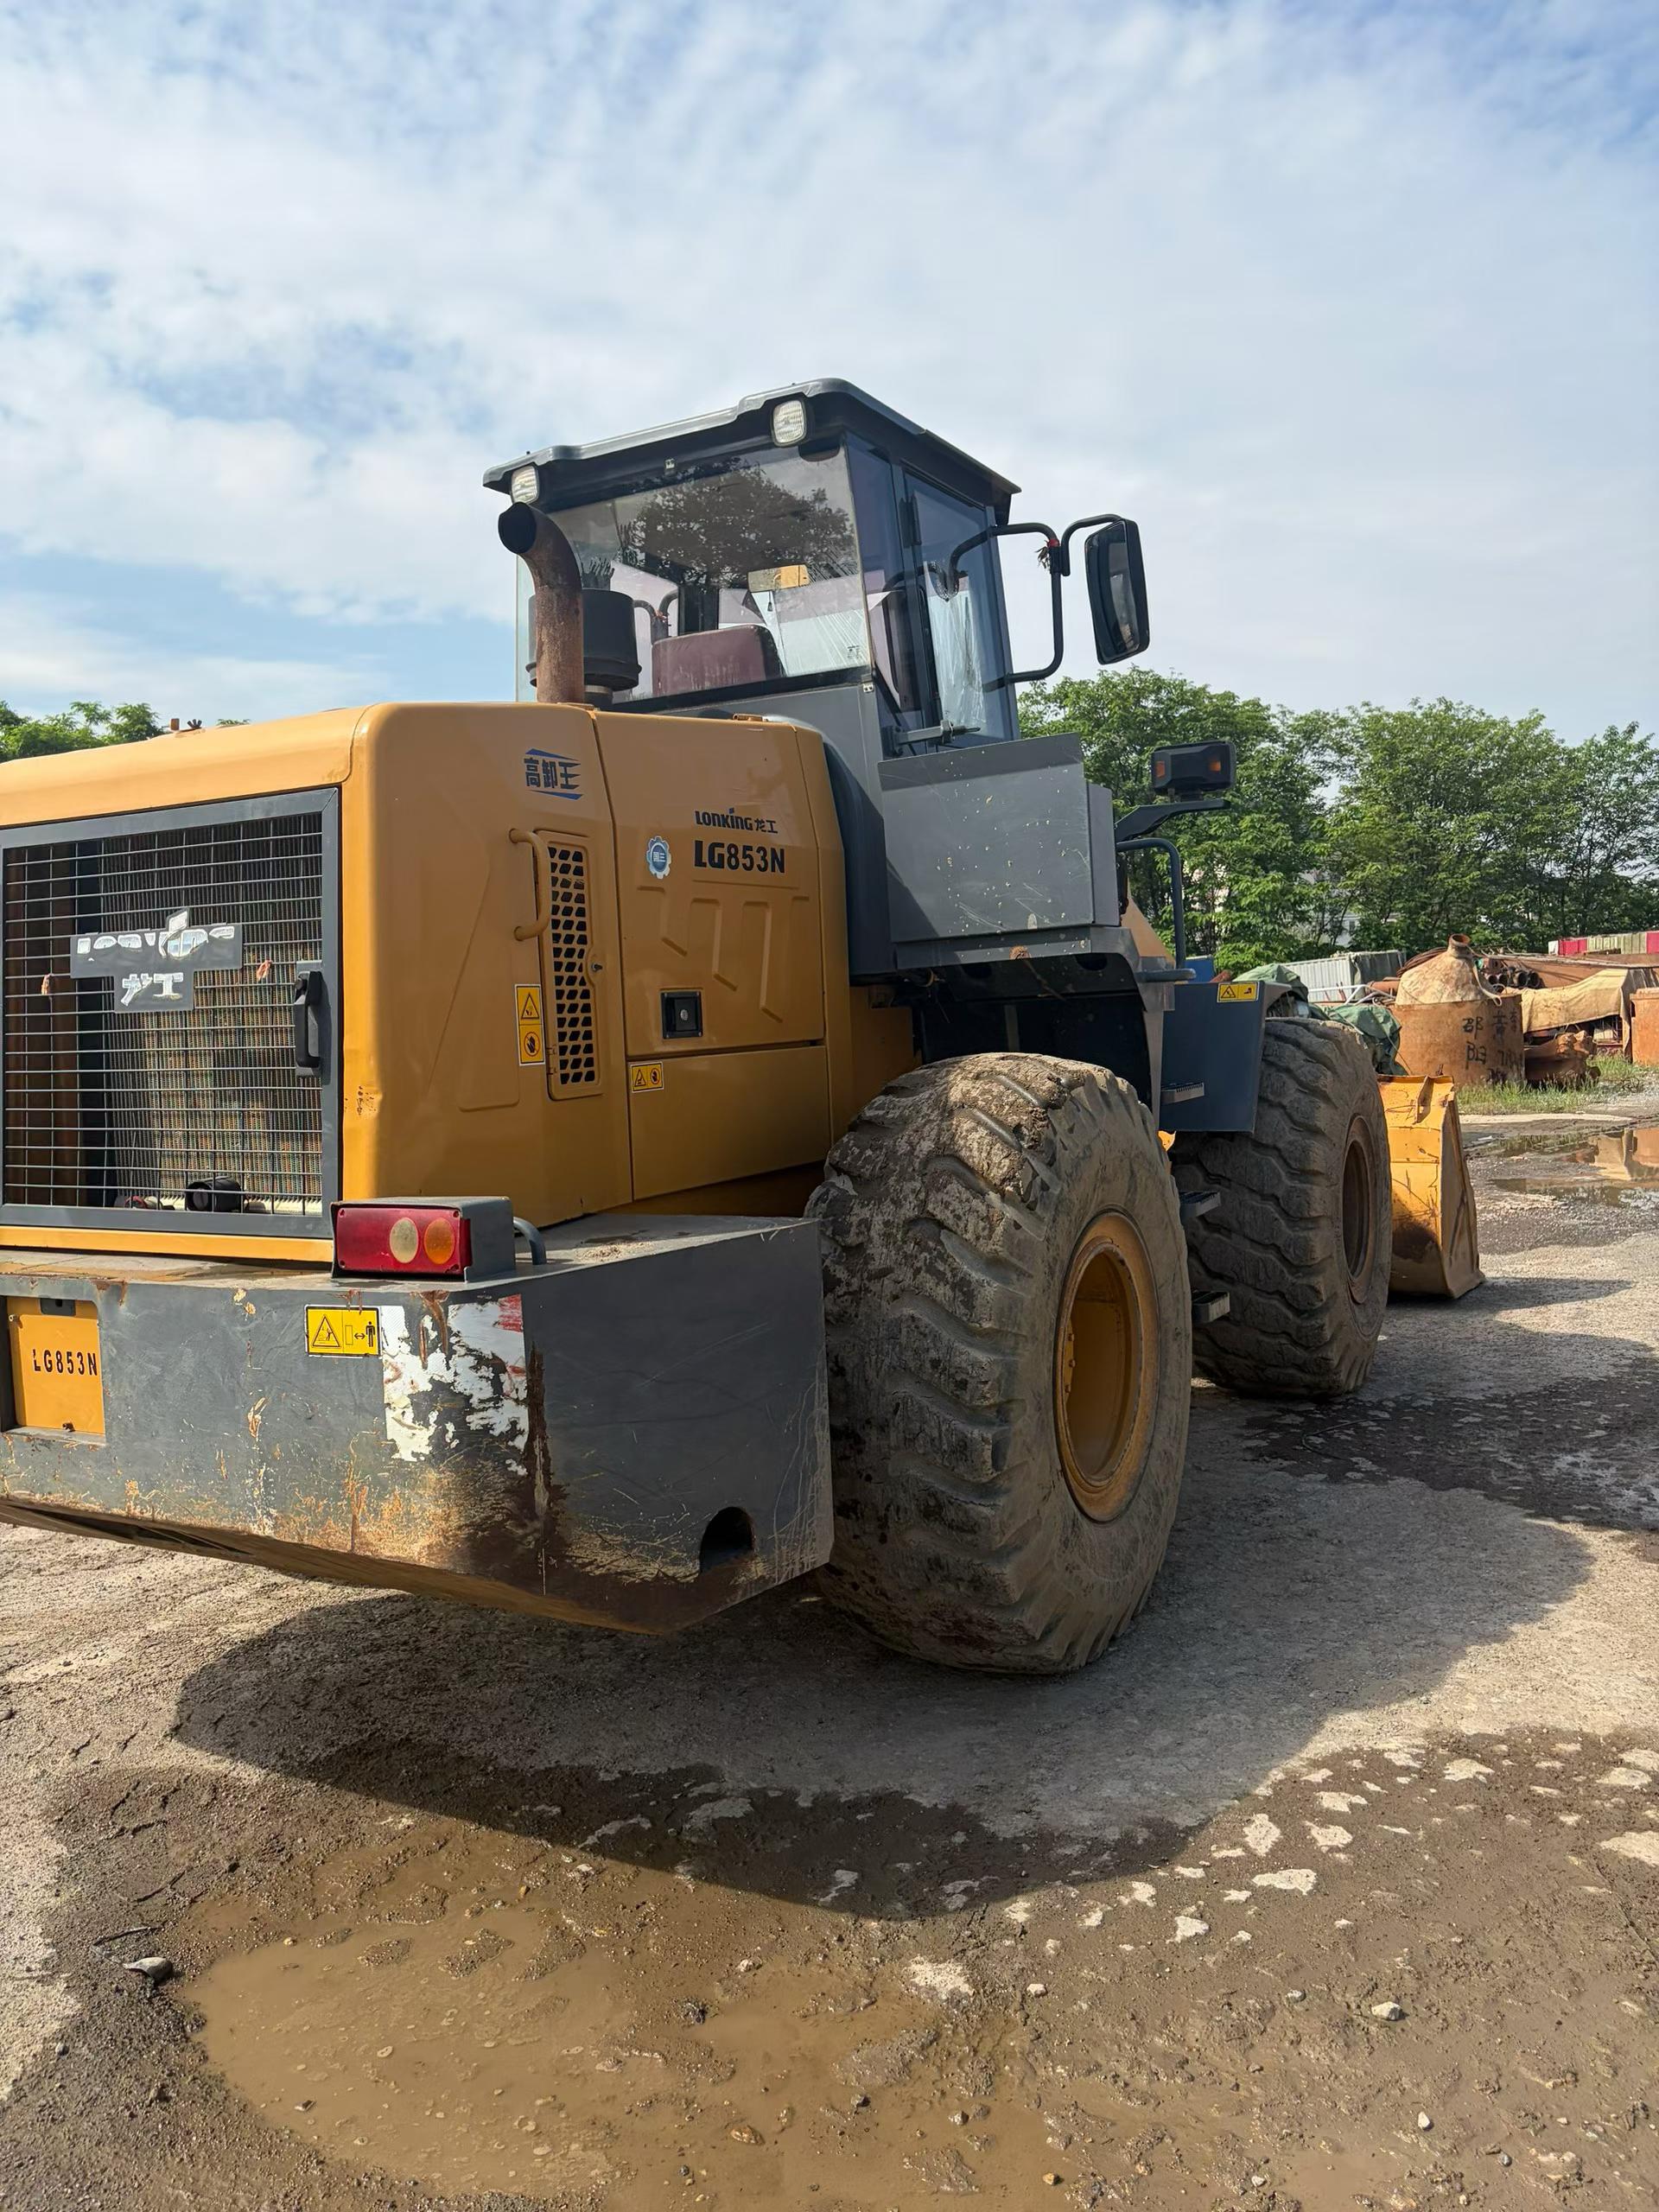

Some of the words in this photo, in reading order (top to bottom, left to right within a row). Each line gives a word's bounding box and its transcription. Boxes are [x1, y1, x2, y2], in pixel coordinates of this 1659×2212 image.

[524, 757, 582, 790] 高卸王
[754, 817, 779, 834] 龙工
[694, 840, 785, 874] LG853N
[33, 1349, 99, 1376] LG853N
